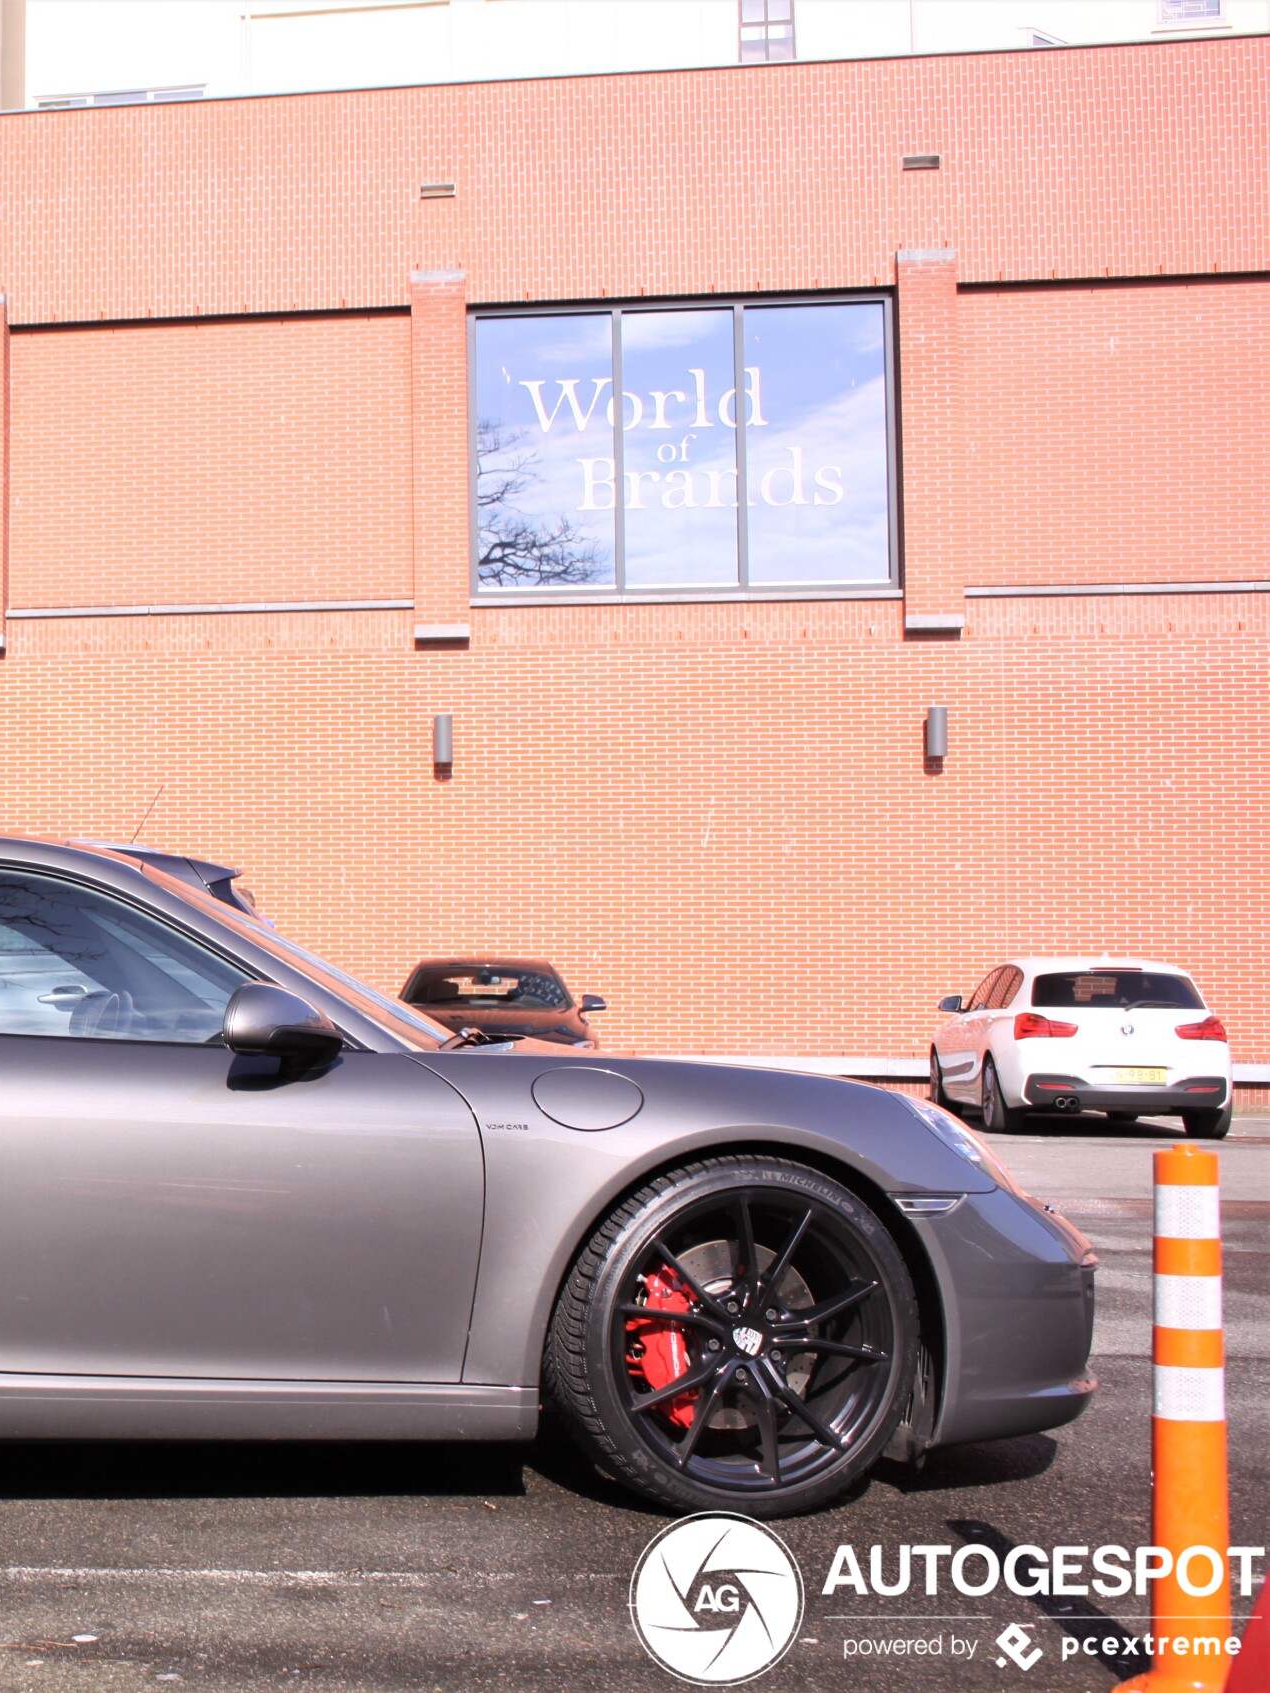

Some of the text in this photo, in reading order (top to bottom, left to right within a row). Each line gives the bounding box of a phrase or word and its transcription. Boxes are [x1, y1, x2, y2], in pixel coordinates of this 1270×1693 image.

[519, 367, 769, 433] World
[575, 446, 845, 511] Brands
[656, 433, 697, 463] of
